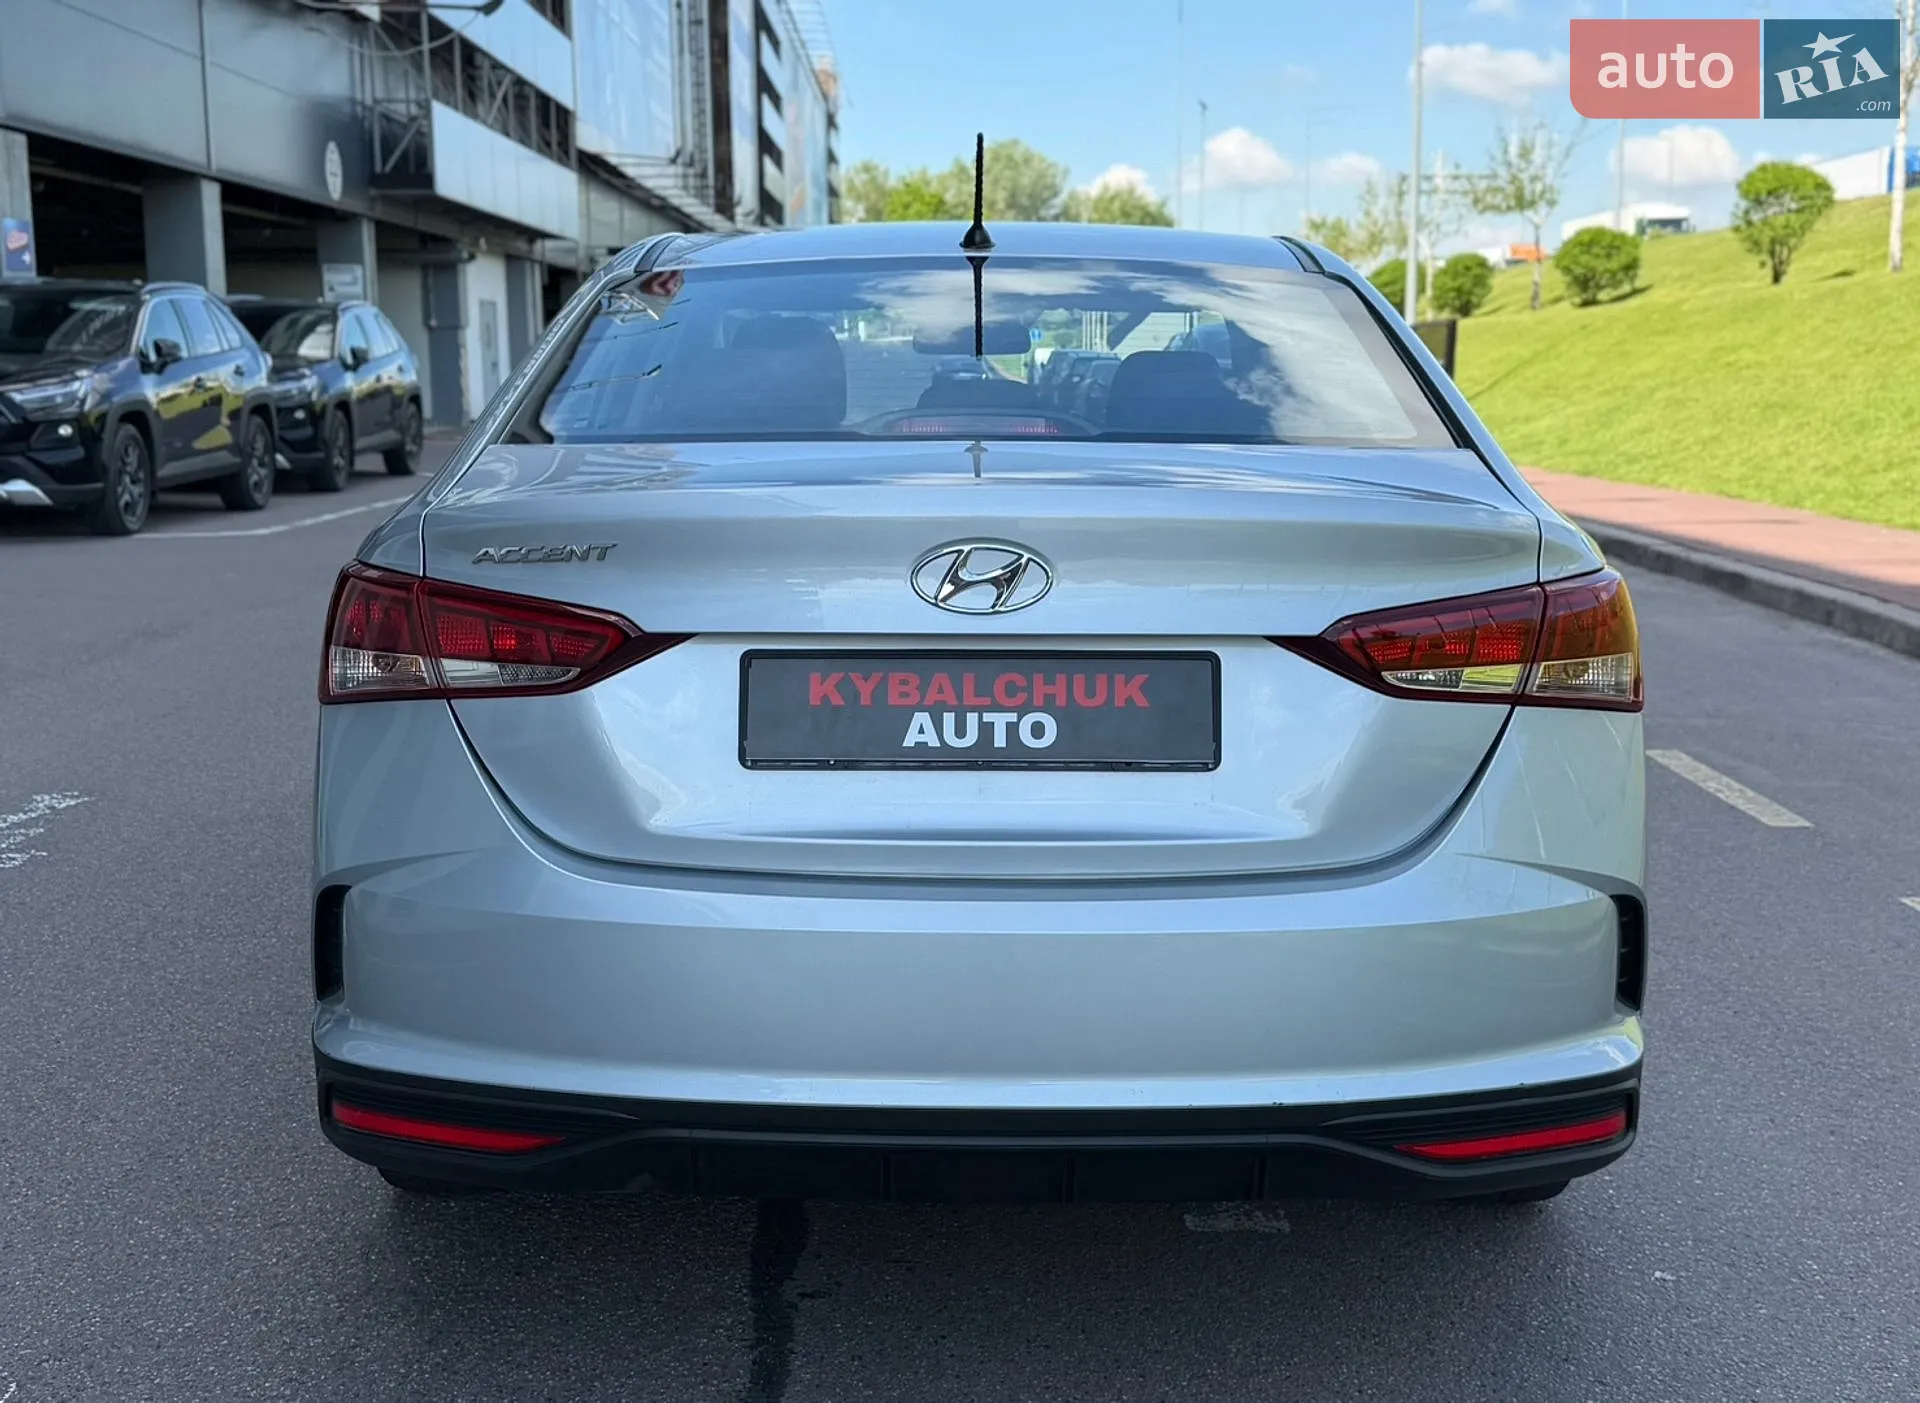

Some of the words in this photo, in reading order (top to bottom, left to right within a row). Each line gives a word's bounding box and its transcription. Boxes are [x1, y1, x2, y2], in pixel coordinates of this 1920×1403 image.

[472, 543, 618, 564] ACCENT
[808, 672, 1150, 708] KYBALCHUK
[902, 711, 1058, 749] AUTO
